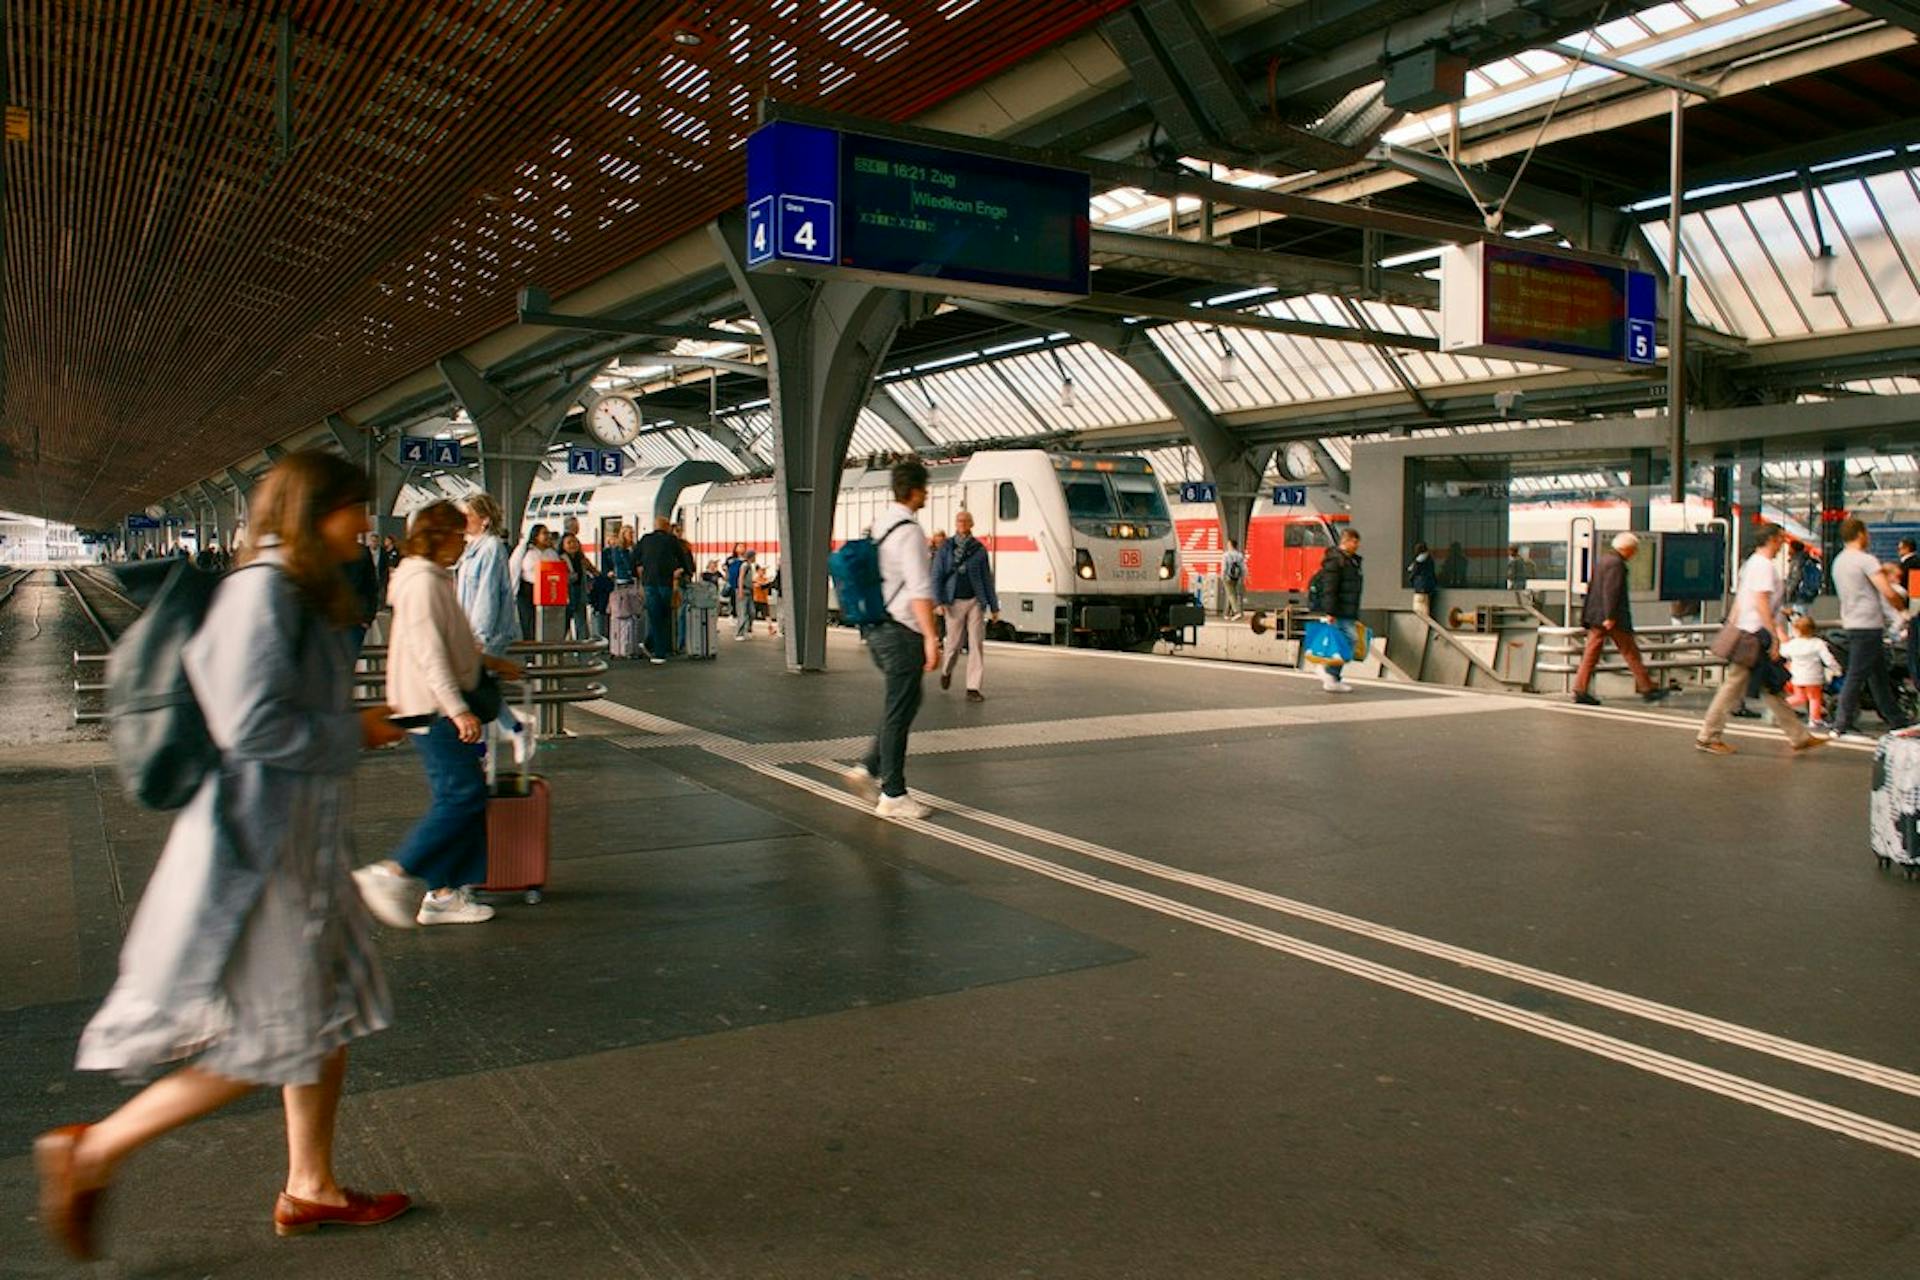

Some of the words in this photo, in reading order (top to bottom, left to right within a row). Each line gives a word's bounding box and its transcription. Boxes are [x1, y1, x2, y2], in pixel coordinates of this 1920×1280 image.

[930, 168, 957, 189] Zug
[913, 191, 973, 213] Wiedikon
[974, 200, 1008, 220] Enge
[754, 222, 766, 252] 4
[794, 221, 817, 252] 4
[1636, 335, 1648, 357] 5
[408, 445, 422, 461] 4
[440, 446, 454, 463] A
[576, 455, 590, 471] A
[604, 457, 617, 472] 5
[1203, 488, 1212, 501] A
[1295, 491, 1303, 504] 7
